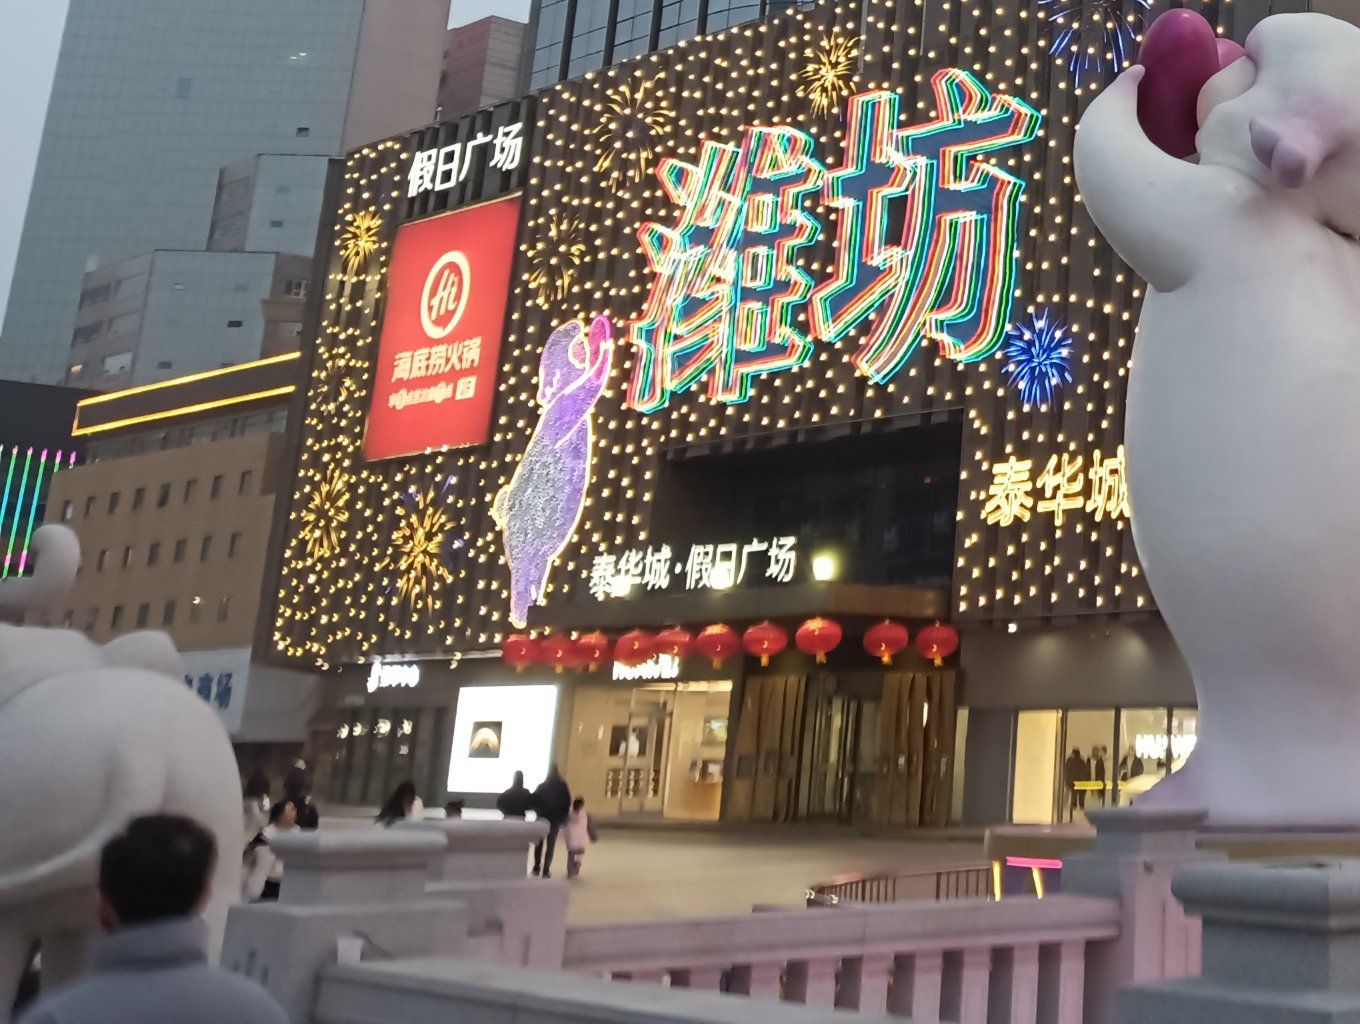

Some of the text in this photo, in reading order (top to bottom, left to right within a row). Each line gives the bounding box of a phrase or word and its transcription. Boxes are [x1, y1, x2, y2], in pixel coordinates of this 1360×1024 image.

[407, 122, 524, 198] 假日广场
[626, 67, 1043, 414] 潍坊
[984, 444, 1131, 527] 泰华城
